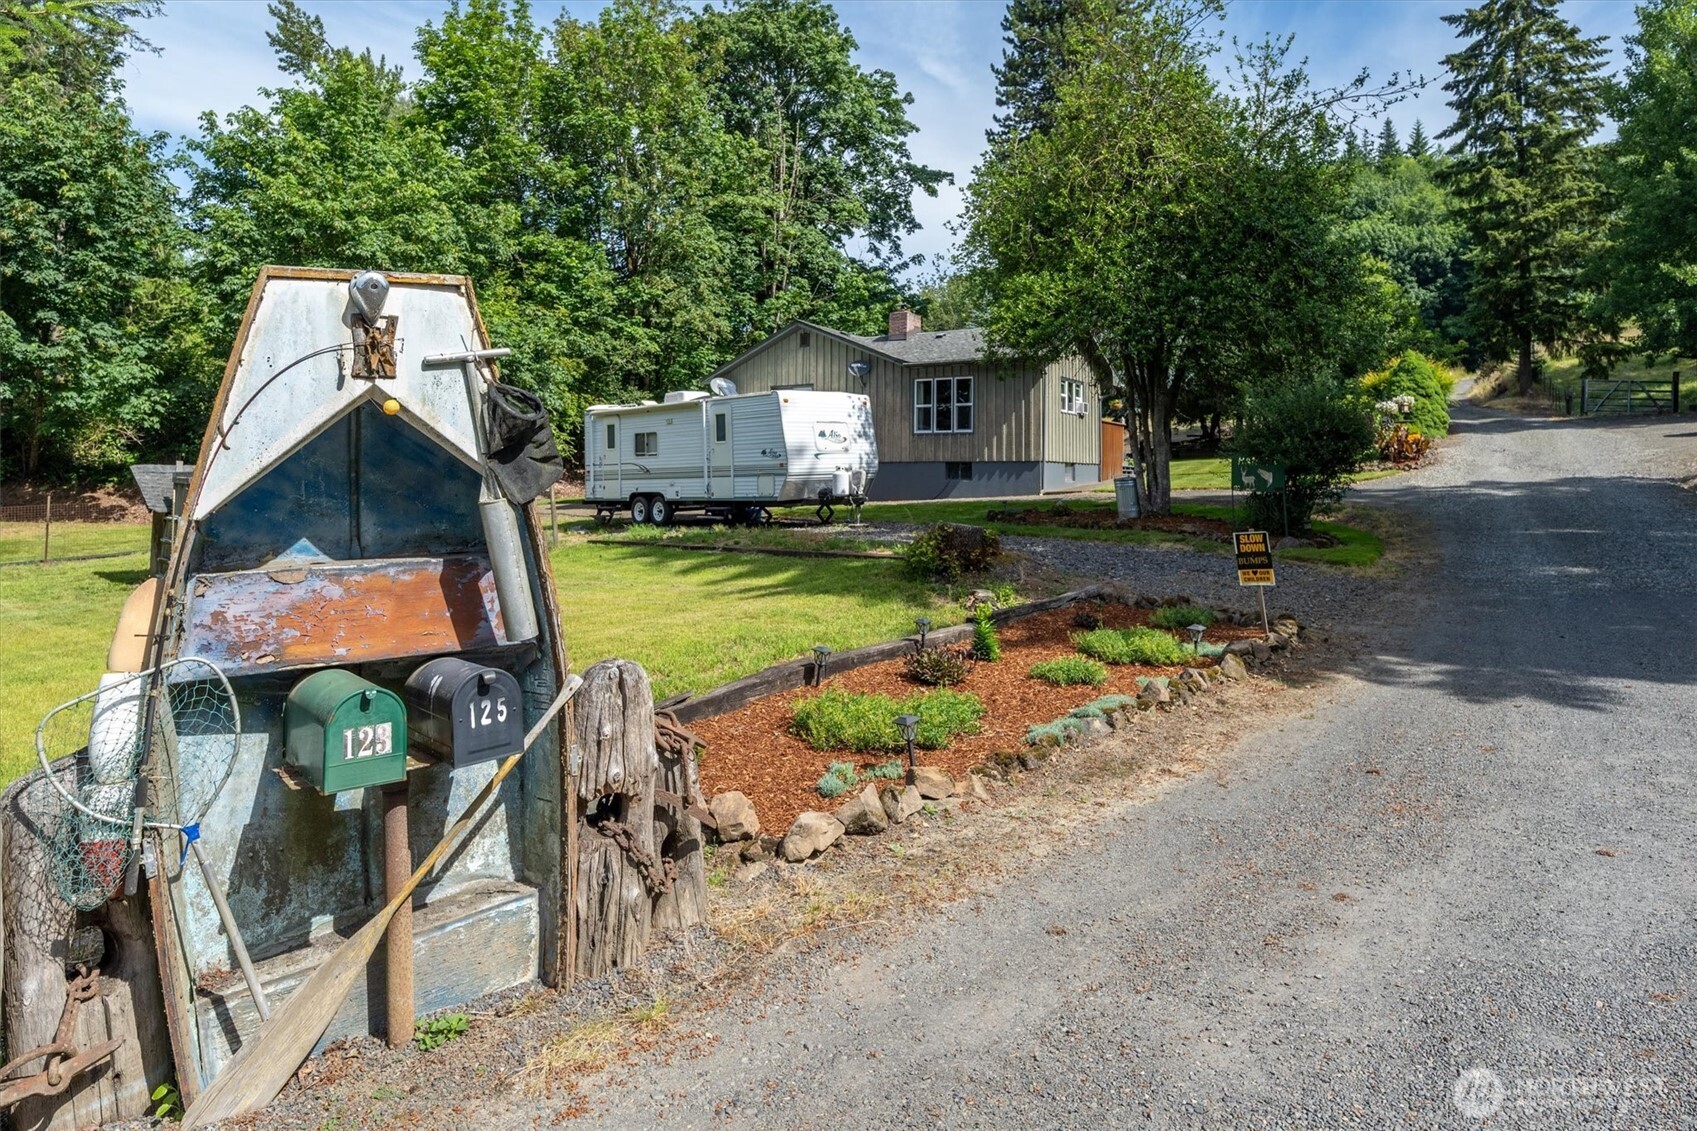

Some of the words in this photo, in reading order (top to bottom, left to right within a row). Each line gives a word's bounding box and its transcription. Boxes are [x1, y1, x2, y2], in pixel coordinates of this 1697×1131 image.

[1239, 534, 1263, 543] SLOW
[1240, 543, 1266, 552] DOWN
[1238, 556, 1268, 565] BUMPS
[469, 697, 507, 729] 125
[344, 722, 392, 760] 123
